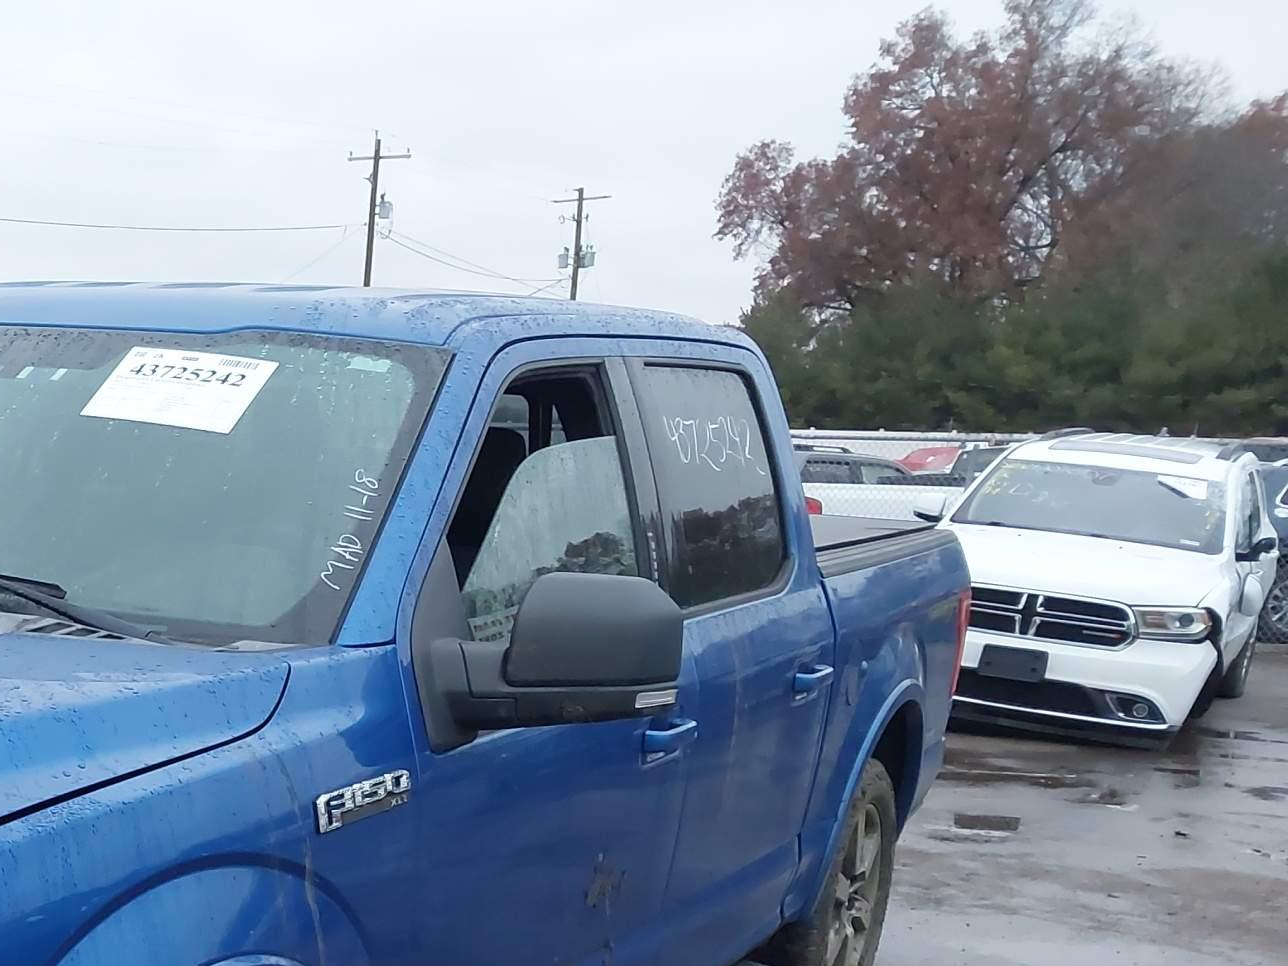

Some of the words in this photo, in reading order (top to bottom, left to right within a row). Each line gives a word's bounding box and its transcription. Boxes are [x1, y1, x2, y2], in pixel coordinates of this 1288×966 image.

[129, 363, 247, 387] 43725242
[319, 533, 365, 591] MAD
[343, 468, 379, 521] 11-18
